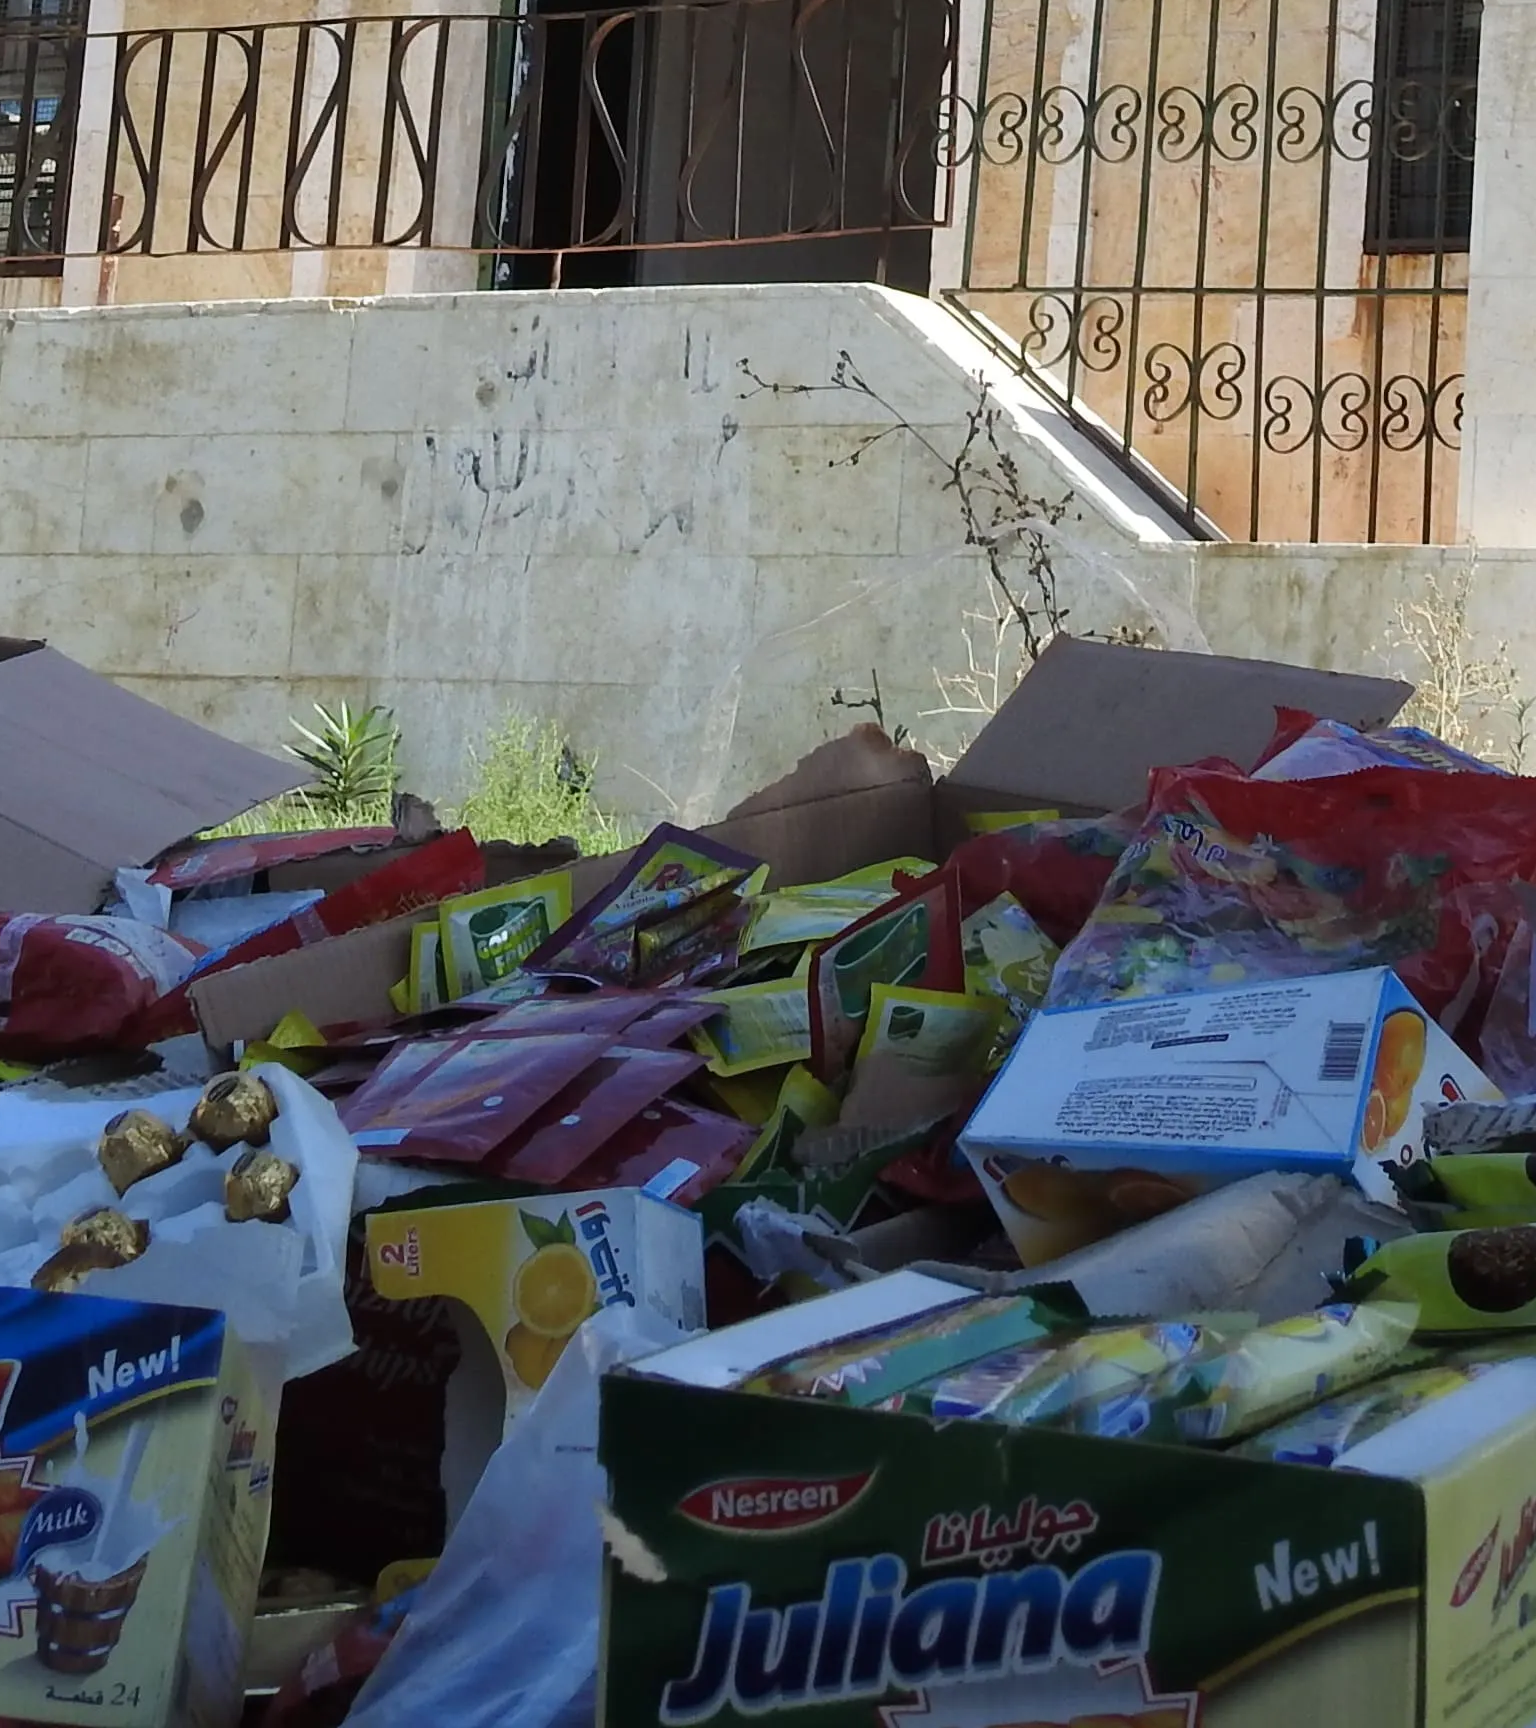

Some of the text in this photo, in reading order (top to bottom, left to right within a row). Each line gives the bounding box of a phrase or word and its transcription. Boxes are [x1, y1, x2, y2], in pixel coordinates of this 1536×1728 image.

[379, 1241, 407, 1269] 2
[406, 1225, 422, 1279] Liters
[86, 1334, 183, 1400] New!
[24, 1505, 90, 1545] Milk
[710, 1484, 840, 1522] Nesreen
[921, 1494, 1100, 1569] جوليانا
[1254, 1520, 1383, 1612] New!
[659, 1549, 1163, 1727] Juliana
[110, 1682, 143, 1709] 24
